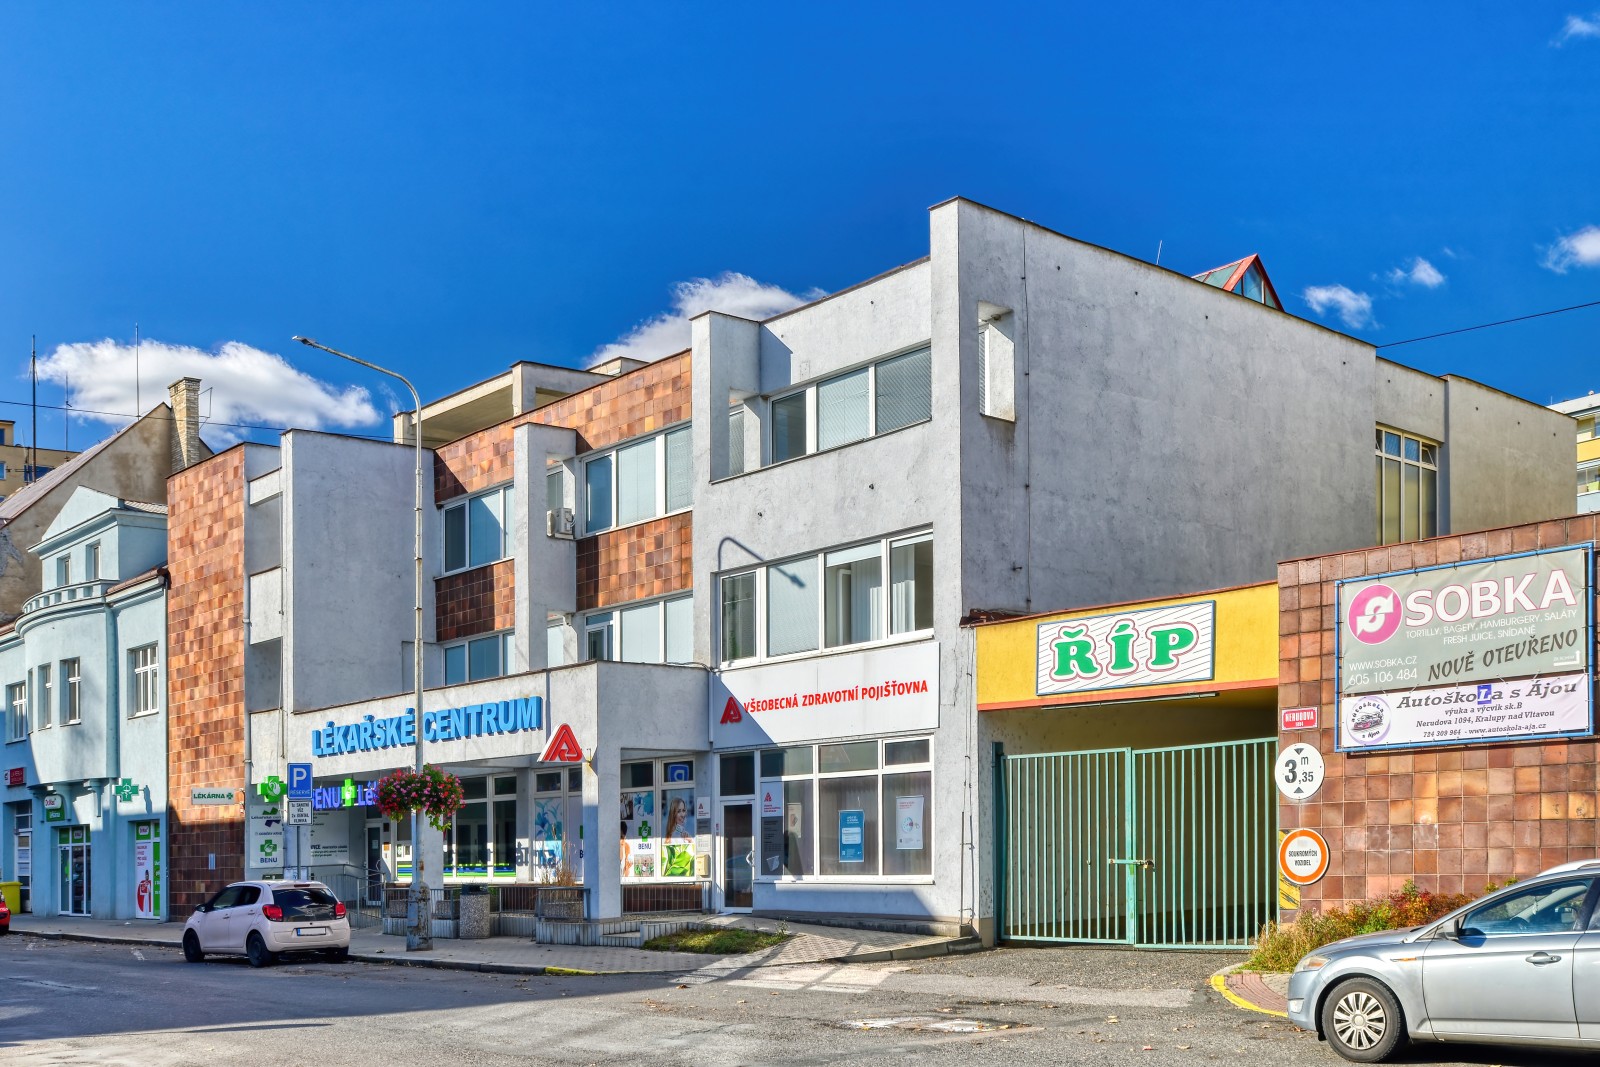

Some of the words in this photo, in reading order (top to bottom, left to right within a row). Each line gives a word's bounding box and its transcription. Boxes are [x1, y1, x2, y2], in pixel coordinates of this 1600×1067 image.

[1405, 569, 1577, 627] SOBKA
[1406, 626, 1442, 639] TORTILLY,
[1443, 623, 1478, 635] BAGETY,
[1480, 615, 1542, 631] HAMBURGERY,
[1544, 609, 1577, 622] SALÁTY
[1443, 634, 1467, 646] FRESH
[1469, 632, 1496, 644] JUICE,
[1497, 624, 1536, 639] SNÍDANĚ
[1052, 621, 1196, 680] ŘÍP
[1427, 651, 1474, 682] NOVĚ
[1483, 628, 1578, 668] OTEVŘENO
[1349, 655, 1418, 672] WWW.SOBKA.CZ
[1349, 673, 1370, 687] 605
[1373, 671, 1394, 683] 106
[1396, 668, 1418, 681] 484
[744, 693, 799, 713] VŠEOBECNÁ
[802, 685, 859, 707] ZDRAVOTNÍ
[861, 679, 928, 701] POJIŠŤOVNA
[1509, 686, 1521, 699] s
[1526, 679, 1577, 701] Ájou
[1285, 711, 1314, 722] NERUDOVA
[1416, 719, 1452, 728] Nerudova
[1454, 716, 1474, 724] 1094,
[1474, 714, 1506, 723] Kralupy
[1508, 712, 1523, 720] nad
[1525, 710, 1555, 719] Vltavou
[1445, 707, 1468, 717] výuka
[1477, 704, 1503, 714] výcvik
[1504, 702, 1523, 710] sk.B
[311, 708, 416, 757] LÉKAŘSKÉ
[423, 695, 543, 743] CENTRUM
[1469, 723, 1547, 735] www.autoskola-aja.cz
[293, 767, 307, 788] P
[312, 786, 341, 809] ENU
[1288, 849, 1318, 858] SOUKROMÝCH
